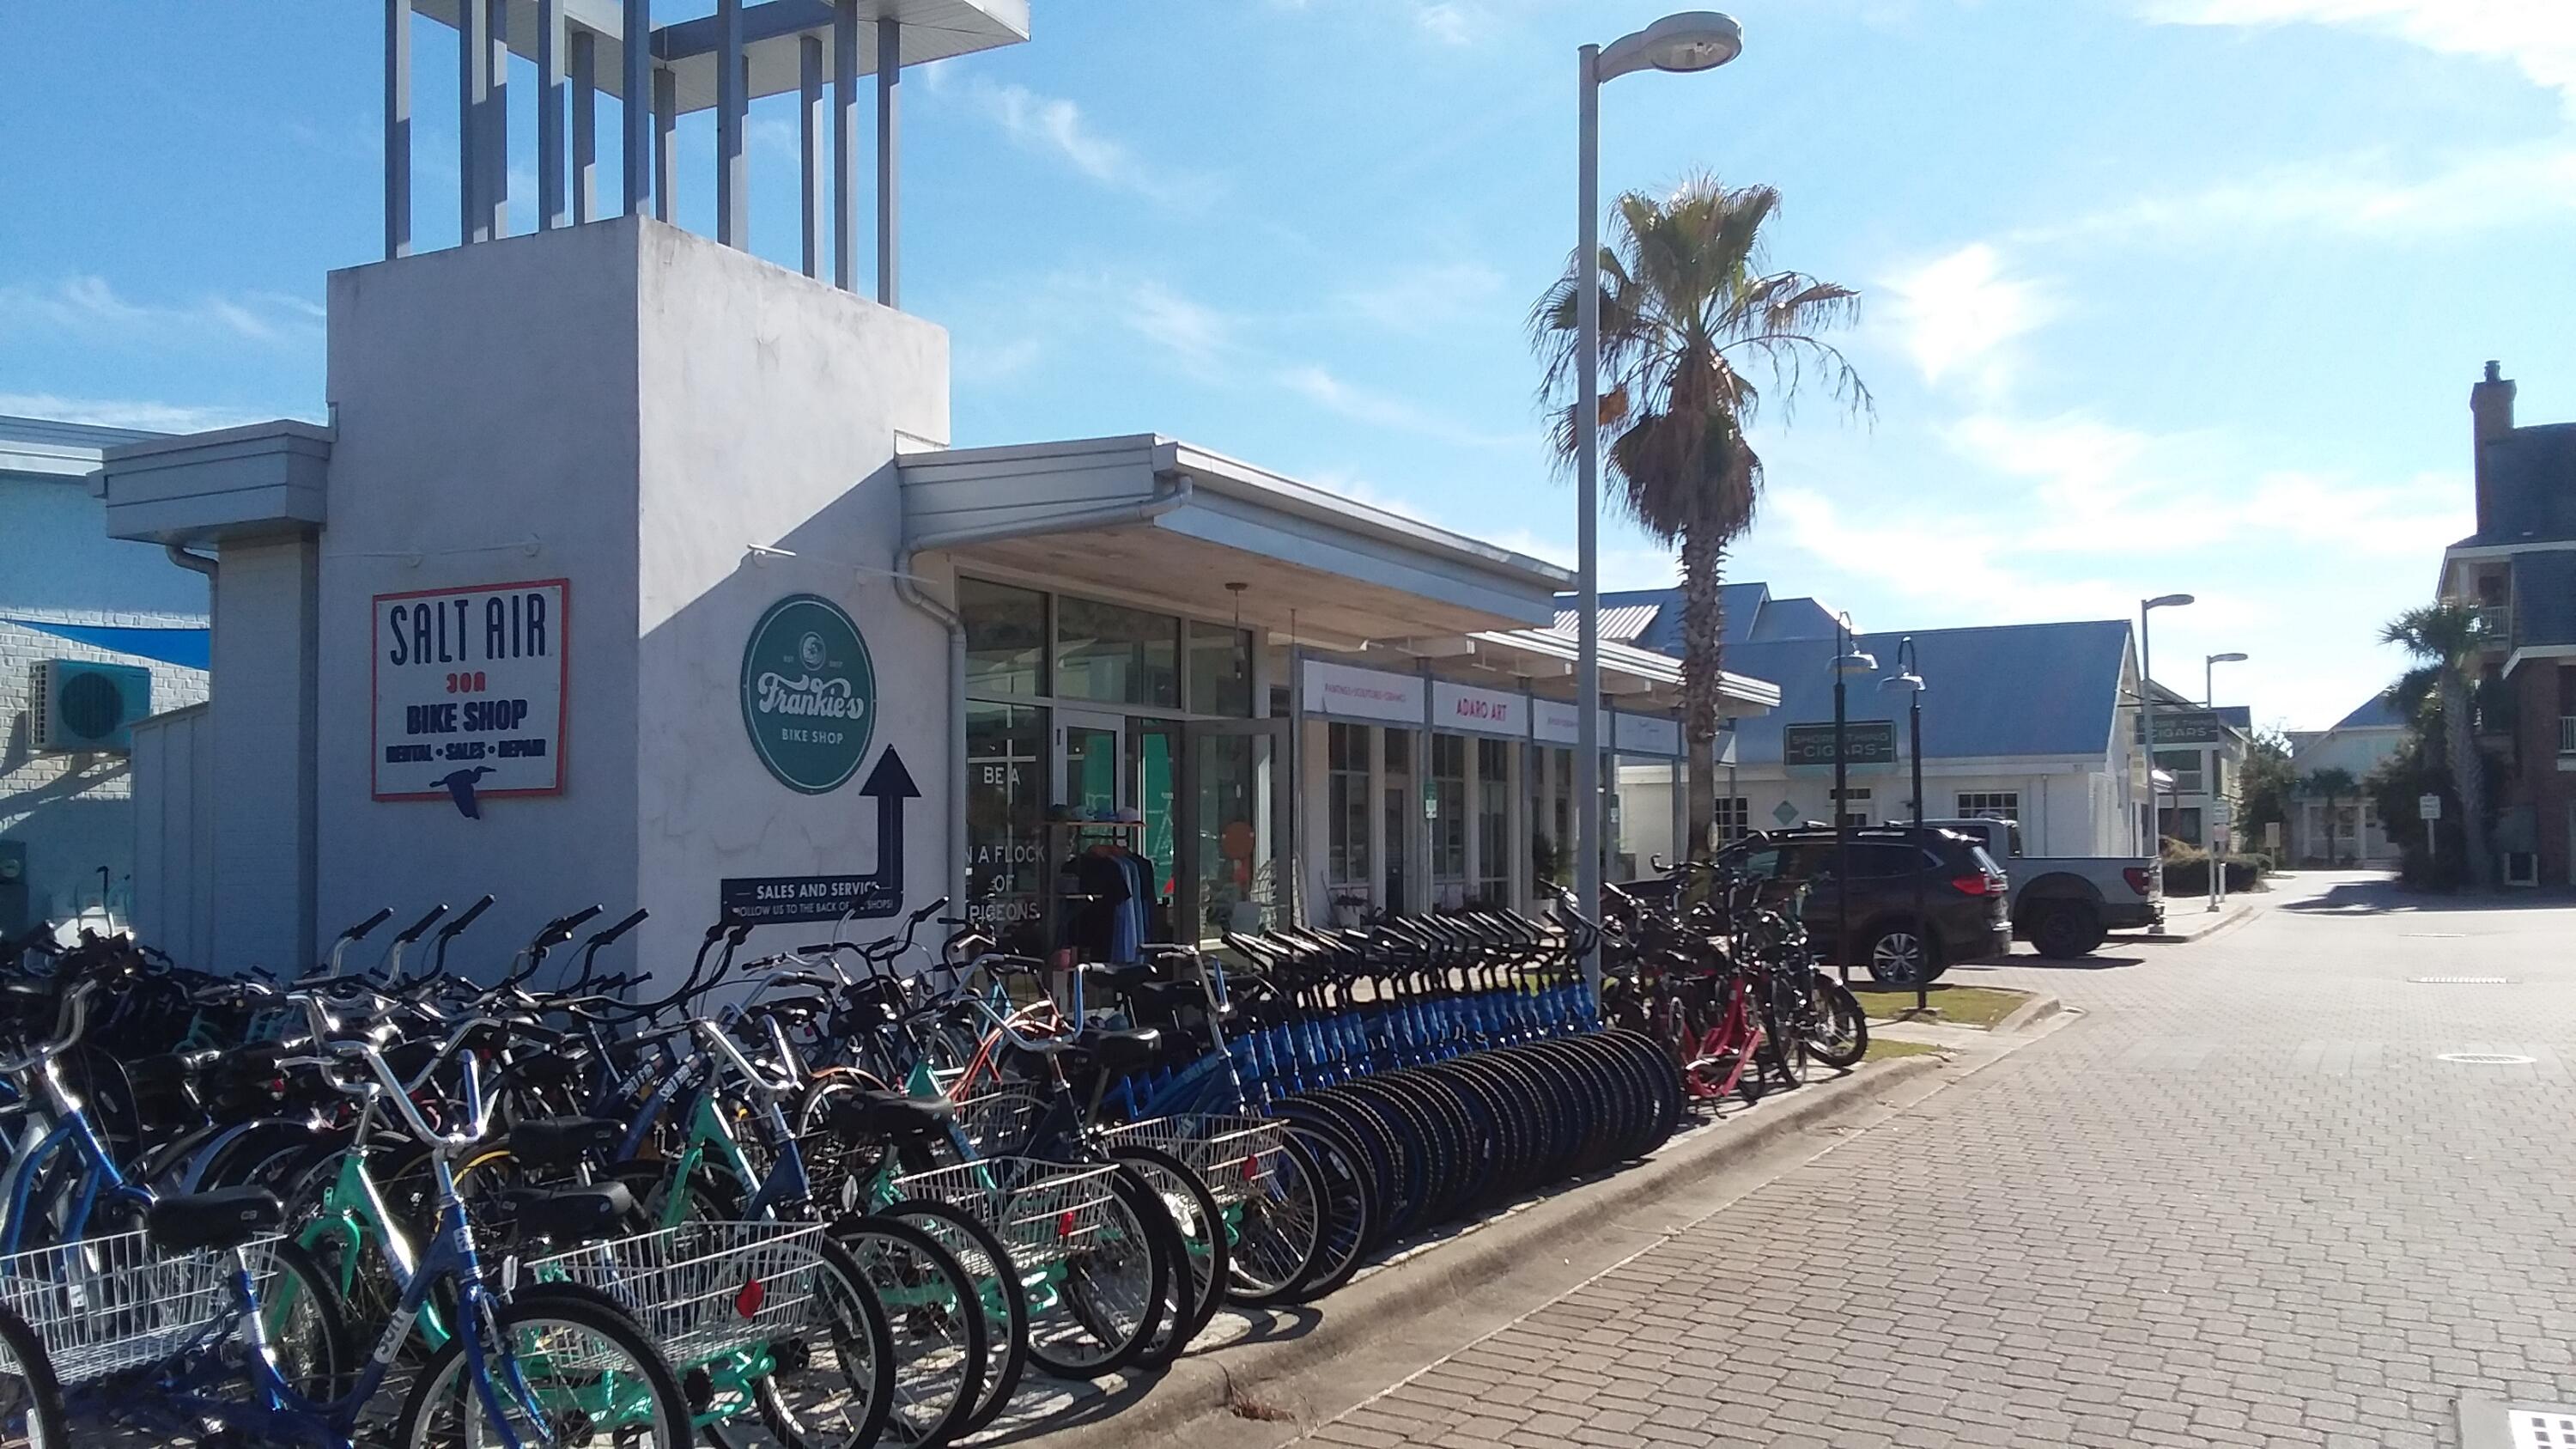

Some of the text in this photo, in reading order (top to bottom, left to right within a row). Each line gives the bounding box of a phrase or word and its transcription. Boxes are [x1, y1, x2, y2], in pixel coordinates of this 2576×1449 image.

[391, 594, 546, 666] SALT AIR
[406, 699, 527, 735] BIKE SHOP
[1456, 697, 1507, 721] ADARO ART
[781, 728, 844, 745] BIKE SHOP
[446, 742, 486, 760] SALES
[498, 739, 546, 758] REPAIR
[984, 766, 1021, 786] BE A
[978, 846, 989, 863] A
[994, 845, 1045, 863] FLOCK
[756, 884, 795, 900] SALES
[799, 883, 828, 898] AND
[994, 874, 1014, 892] OF
[773, 904, 786, 916] US
[786, 904, 798, 914] TO
[799, 903, 814, 913] THE
[816, 902, 837, 912] BACK
[839, 901, 850, 911] OF
